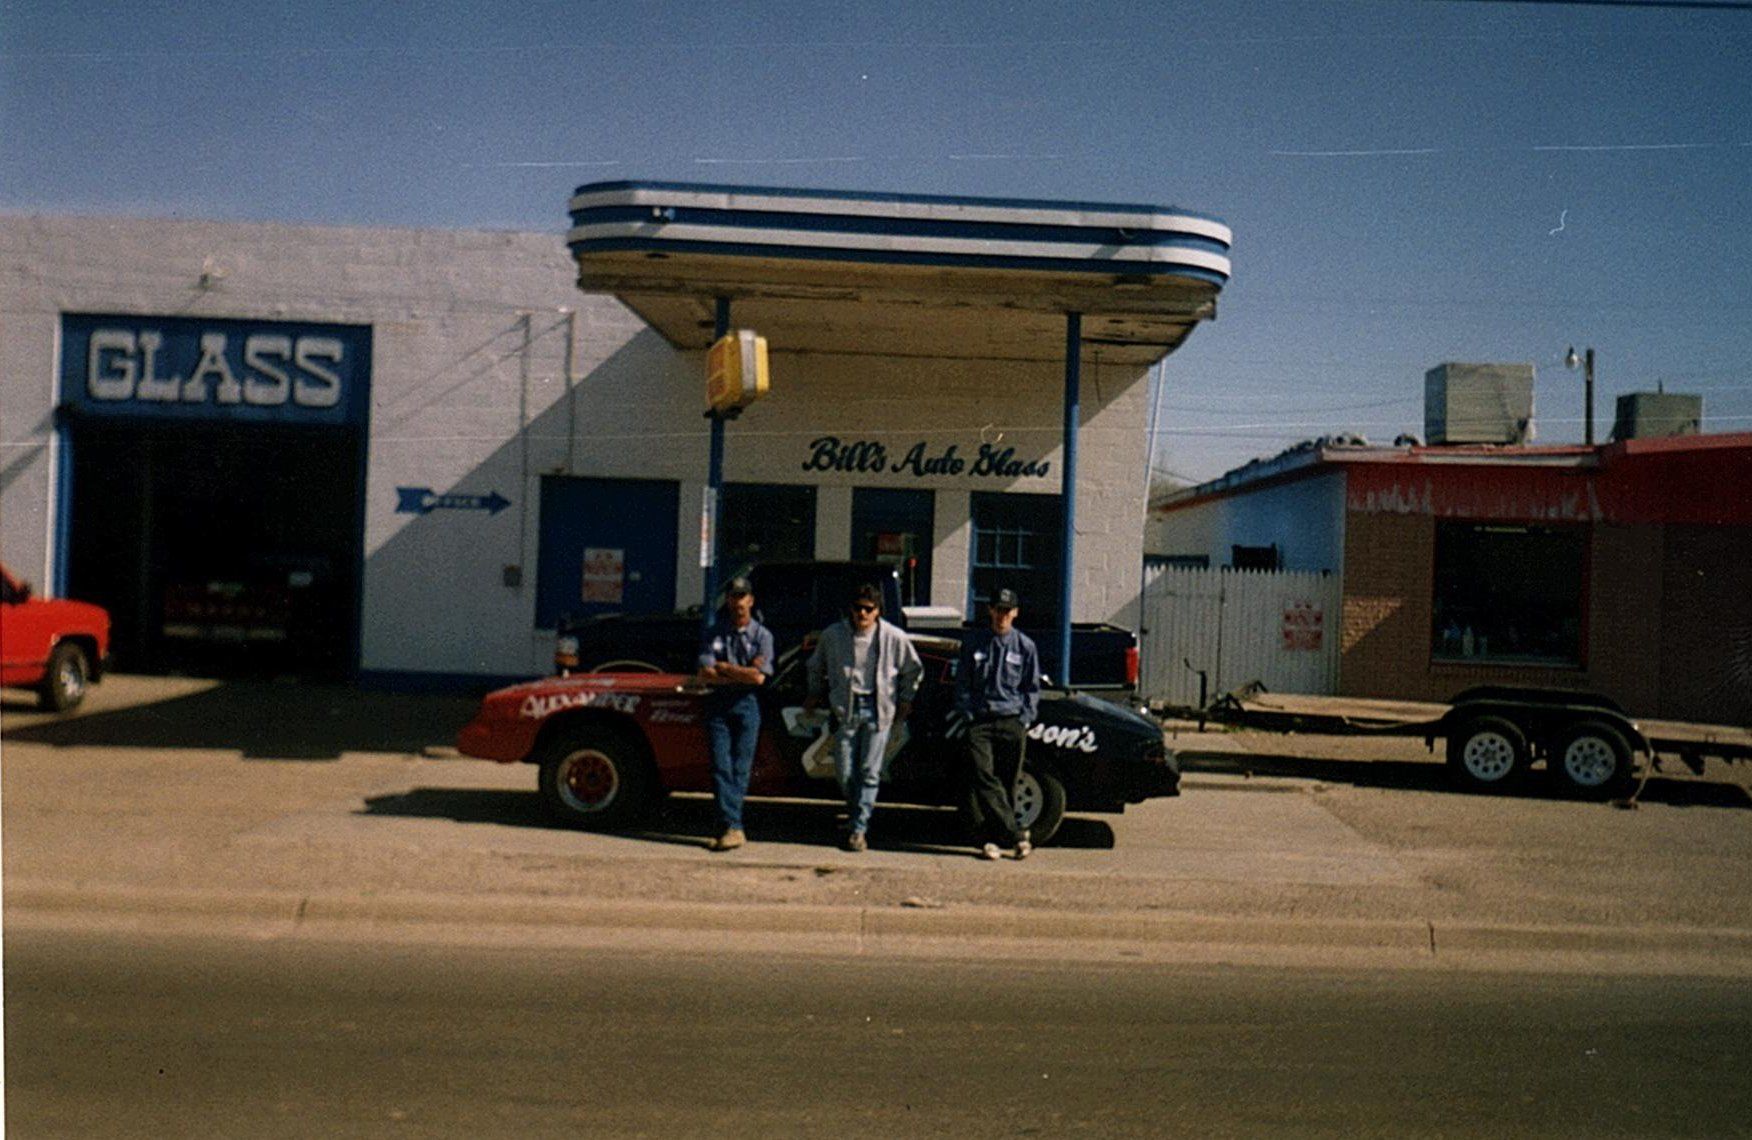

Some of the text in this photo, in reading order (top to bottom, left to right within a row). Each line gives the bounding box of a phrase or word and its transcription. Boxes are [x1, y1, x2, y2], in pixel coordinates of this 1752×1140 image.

[87, 328, 345, 408] GLASS
[801, 435, 1051, 478] Bill's Auto Glass
[1025, 721, 1098, 752] son's
